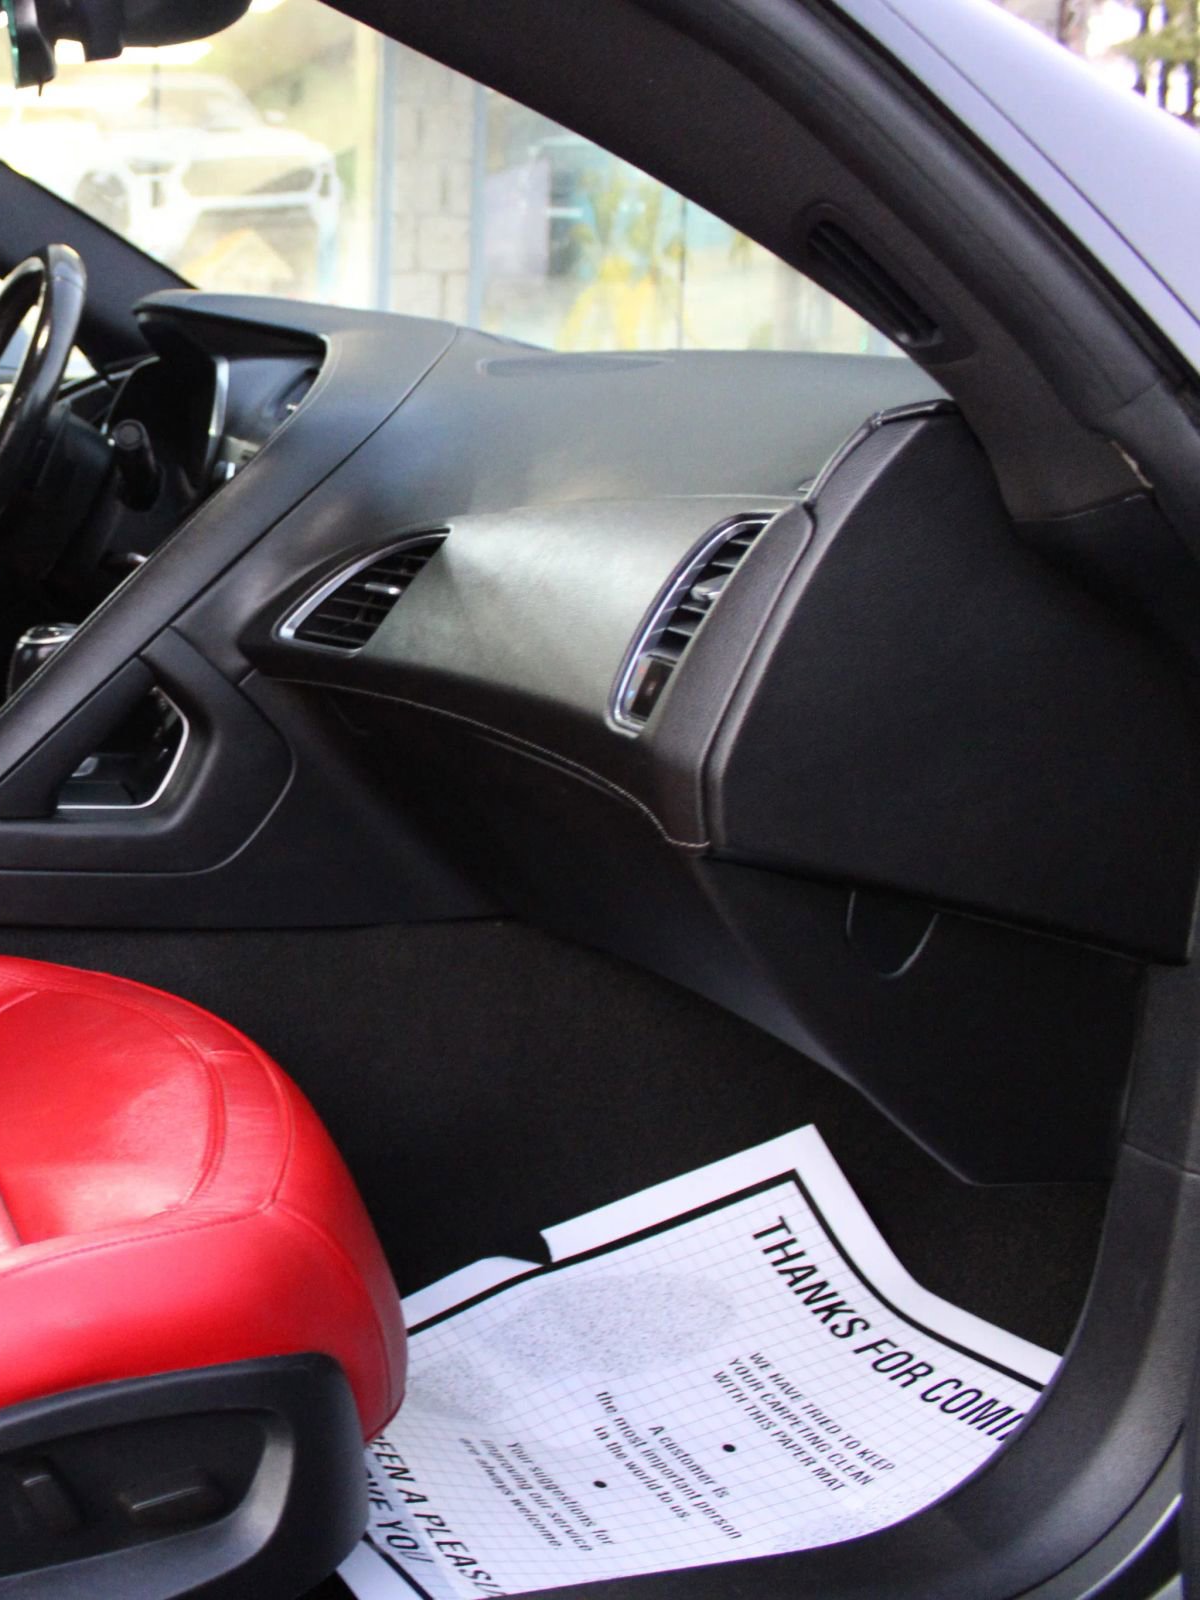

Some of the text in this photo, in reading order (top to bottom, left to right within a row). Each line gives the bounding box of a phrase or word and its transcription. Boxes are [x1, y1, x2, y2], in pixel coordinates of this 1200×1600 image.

[753, 1216, 1024, 1441] THANKS FOR COMI
[593, 1424, 610, 1440] in
[605, 1441, 628, 1460] the
[623, 1460, 664, 1491] world
[656, 1491, 674, 1504] to
[595, 1391, 743, 1540] the most important person
[647, 1425, 730, 1498] A customer is
[712, 1370, 847, 1492] WITH THIS PAPER MAT
[728, 1358, 875, 1486] YOUR CARPETING CLEAN
[750, 1352, 896, 1472] WE HAVE TRIED TO KEEP
[369, 1436, 416, 1482] EEN
[397, 1488, 429, 1504] A
[413, 1513, 508, 1597] PLEASU
[375, 1520, 435, 1563] YOU
[506, 1441, 534, 1464] Your
[528, 1465, 598, 1527] suggestions
[528, 1492, 553, 1509] our
[547, 1512, 594, 1552] service
